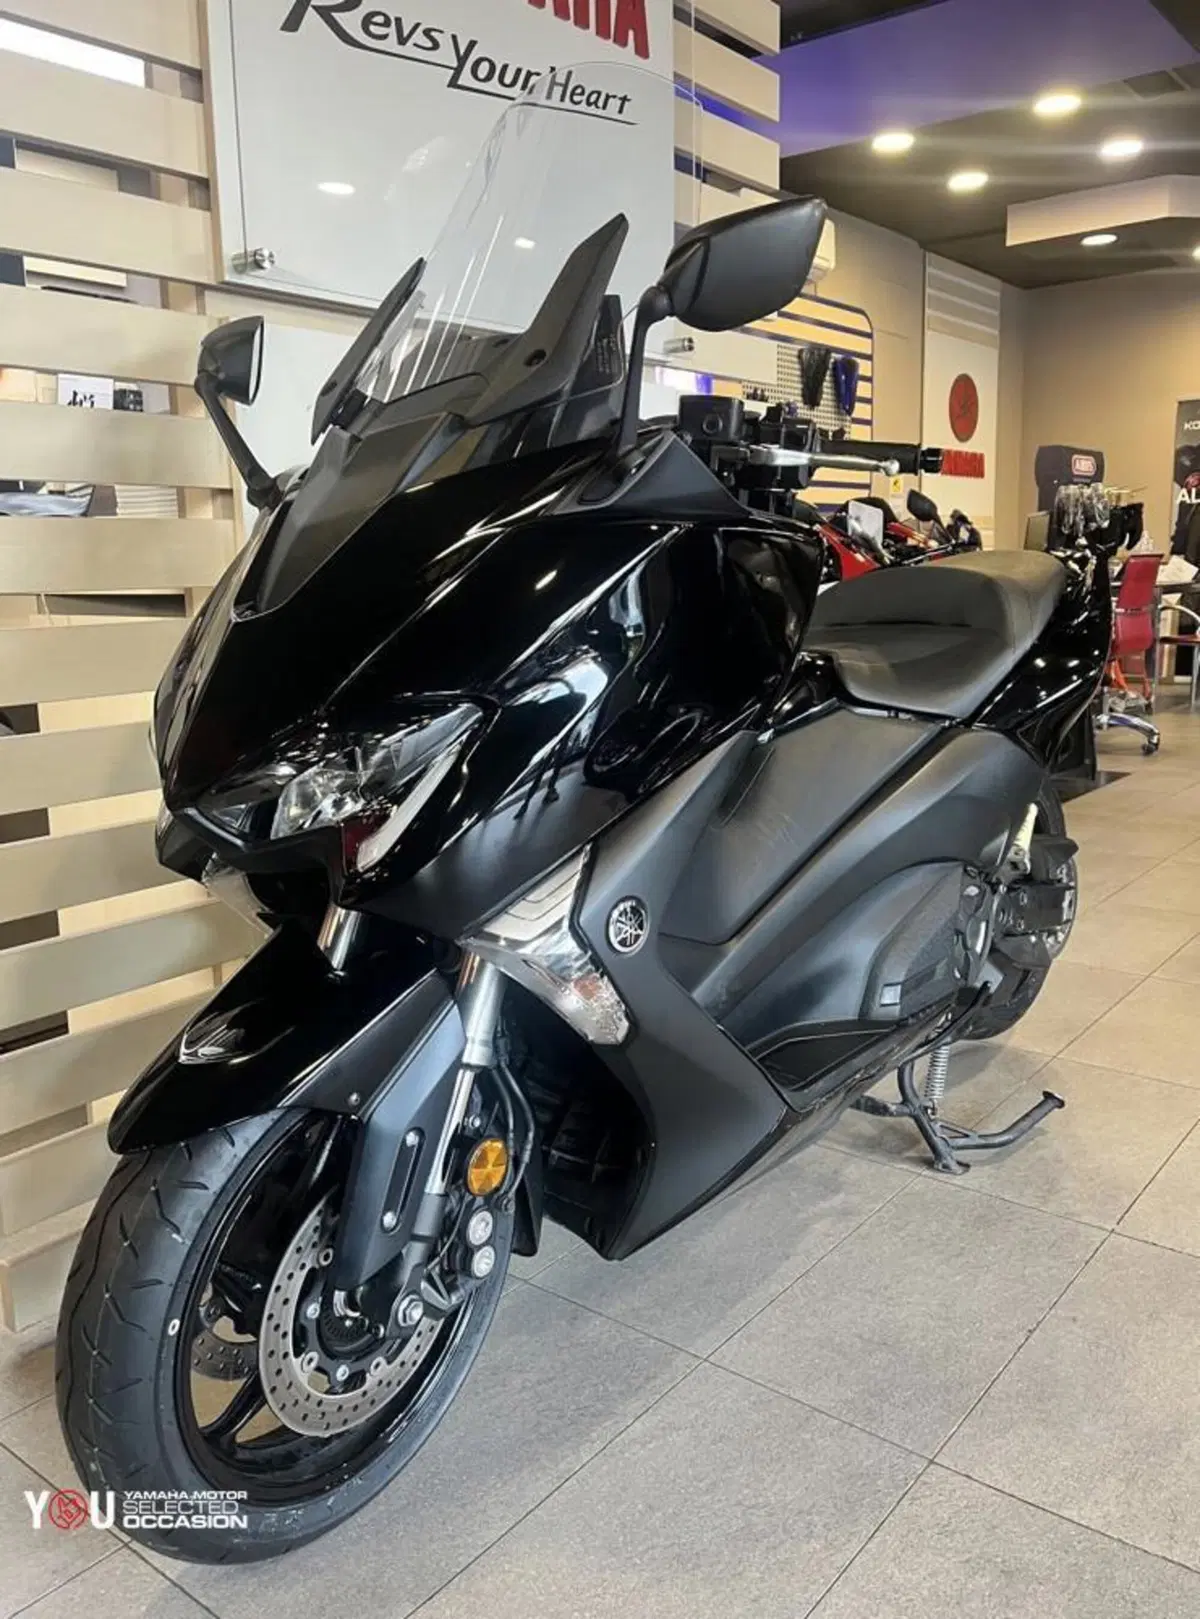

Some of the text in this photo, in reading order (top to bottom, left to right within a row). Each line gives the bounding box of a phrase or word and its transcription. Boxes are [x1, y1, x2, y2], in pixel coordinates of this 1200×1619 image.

[279, 0, 632, 115] Revs Your Heart
